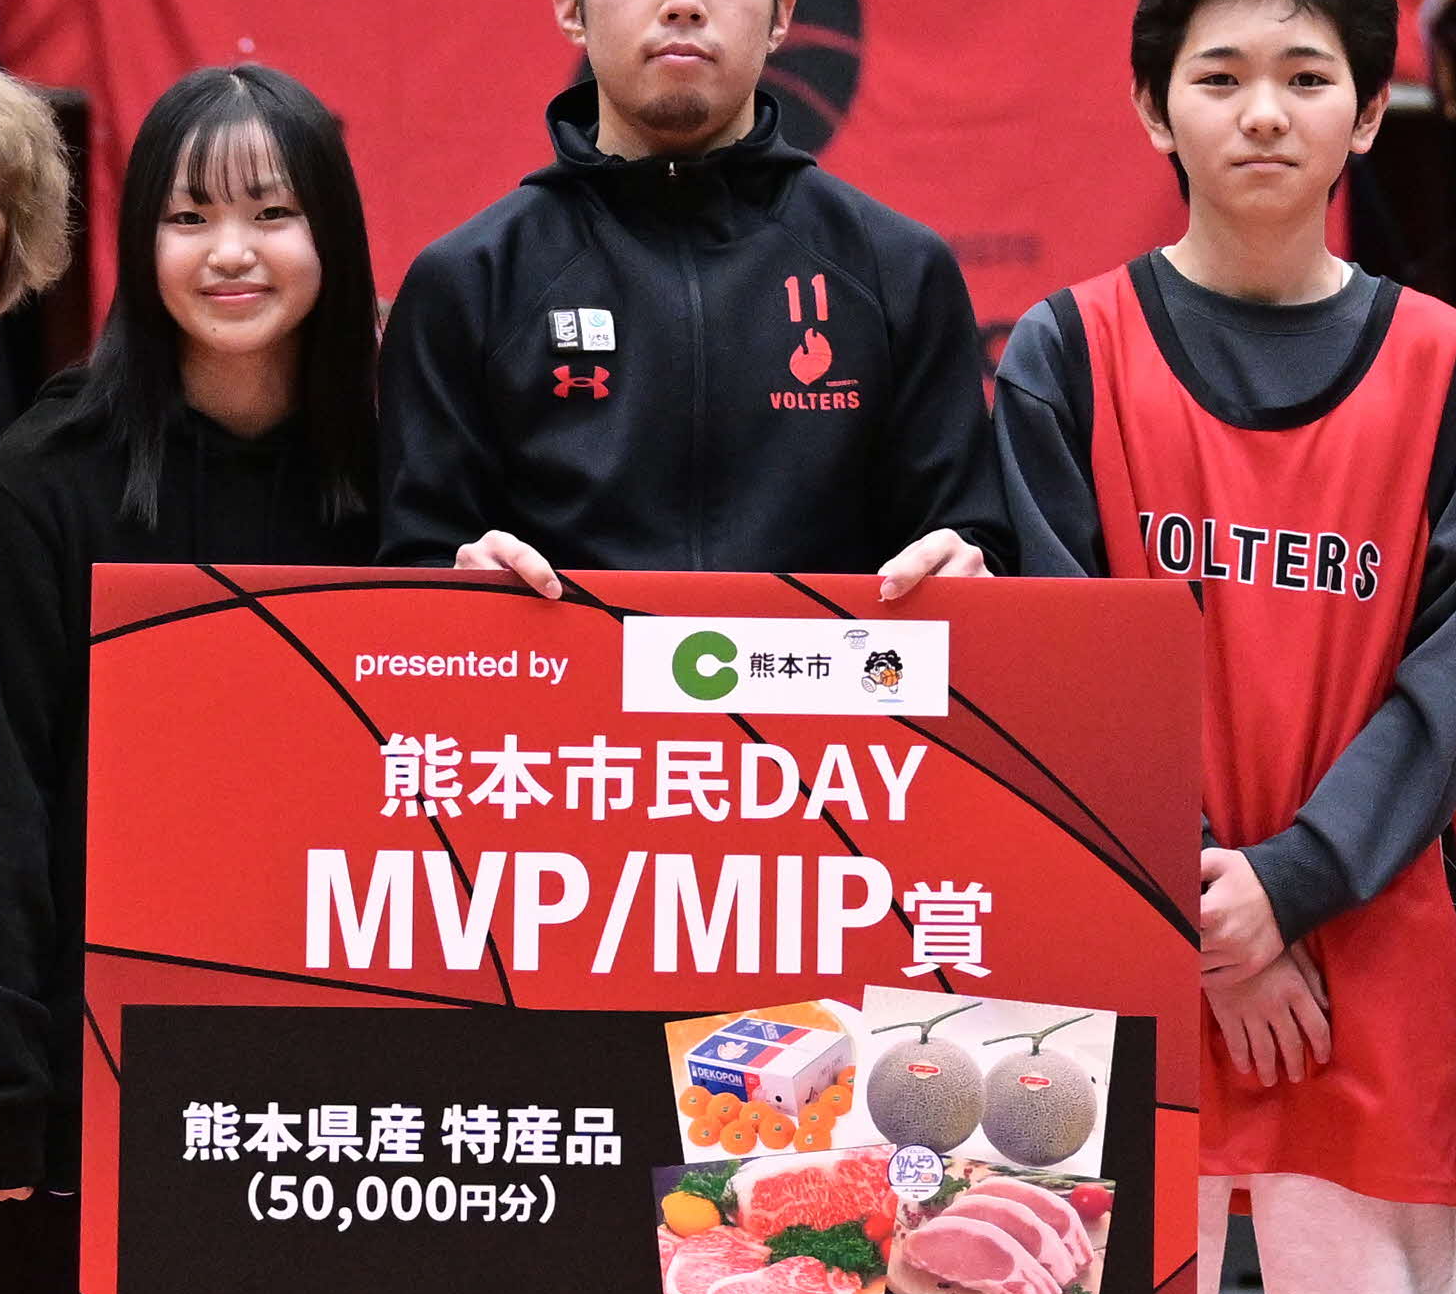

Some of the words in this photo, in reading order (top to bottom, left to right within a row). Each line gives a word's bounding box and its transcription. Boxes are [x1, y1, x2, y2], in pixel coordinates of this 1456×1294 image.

[784, 273, 828, 322] 11
[769, 390, 861, 411] VOLTERS
[355, 651, 520, 686] presented
[529, 651, 571, 686] by
[748, 652, 833, 681] 熊本市
[380, 733, 930, 823] 熊本市民DAY
[306, 849, 994, 980] MVP/MIP賞
[697, 1067, 743, 1085] DEKOPON
[181, 1101, 426, 1162] 熊本県産
[440, 1103, 623, 1166] 特産品
